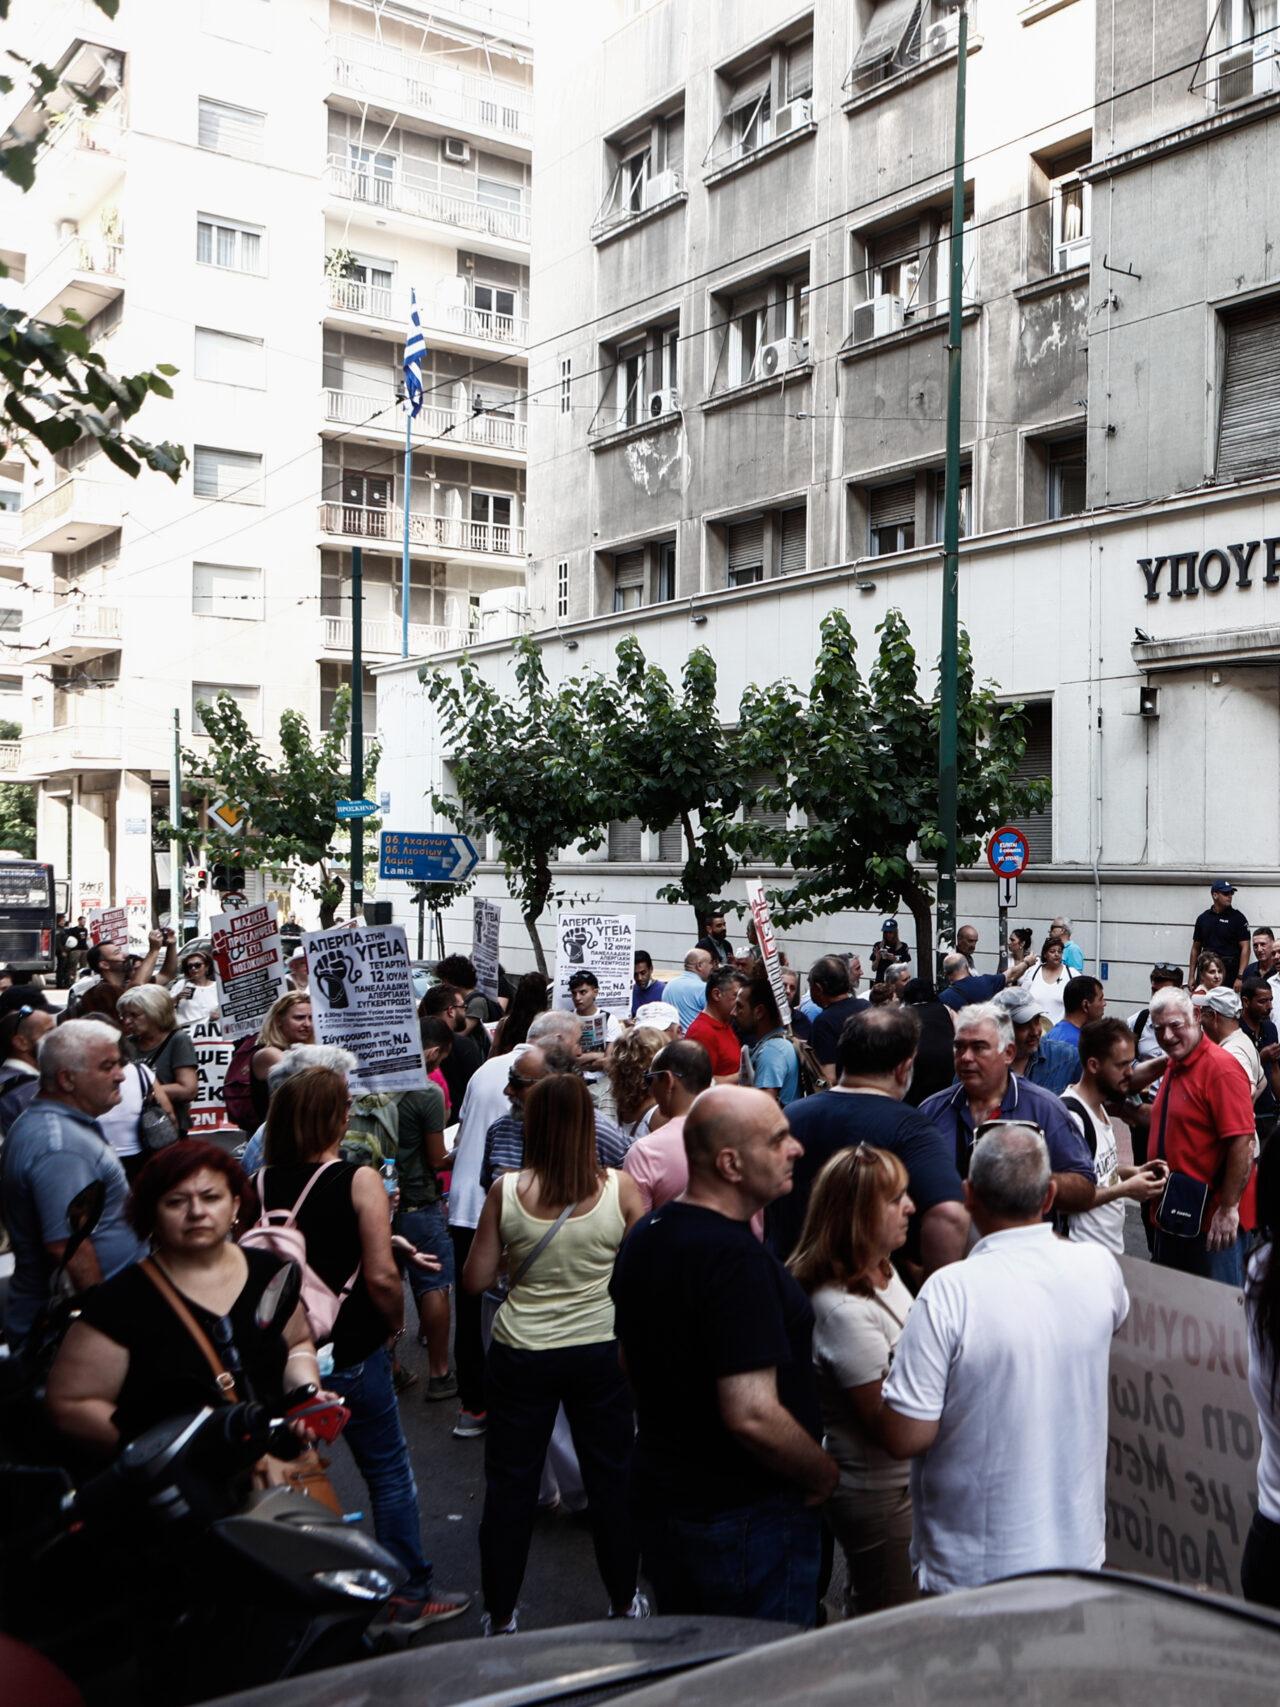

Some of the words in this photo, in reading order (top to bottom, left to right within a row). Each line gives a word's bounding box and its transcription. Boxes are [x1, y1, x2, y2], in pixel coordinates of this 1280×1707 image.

[384, 866, 414, 875] Lamia
[233, 909, 267, 930] ΜΑΖΙΚΕΣ
[562, 917, 602, 927] ΑΠΕΡΓΙΑ
[228, 923, 277, 949] ΠΡΟΣΛΗΨΕΙΣ
[596, 925, 631, 936] ΥΓΕΙΑ
[249, 943, 262, 955] ΣΤΑ
[309, 932, 364, 954] ΑΠΕΡΓΙΑ
[365, 932, 385, 942] ΣΤΗΝ
[356, 939, 405, 961] ΥΓΕΙΑ
[232, 952, 276, 975] ΝΟΣΟΚΟΜΕΙΑ
[370, 960, 406, 970] ΤΕΤΑΡΤΗ
[370, 970, 384, 982] 12
[386, 971, 408, 980] ΙΟΥΛΗ
[355, 983, 409, 993] ΠΑΝΕΛΛΑΔΙΚΗ
[368, 991, 410, 1000] ΑΠΕΡΓΙΑΚΗ
[357, 998, 411, 1008] ΣΥΓΚΕΝΤΡΩΣΗ
[322, 1031, 372, 1045] Σύγκρουση
[378, 1039, 392, 1047] της
[393, 1032, 412, 1045] ΝΔ
[386, 1046, 408, 1057] μέρα
